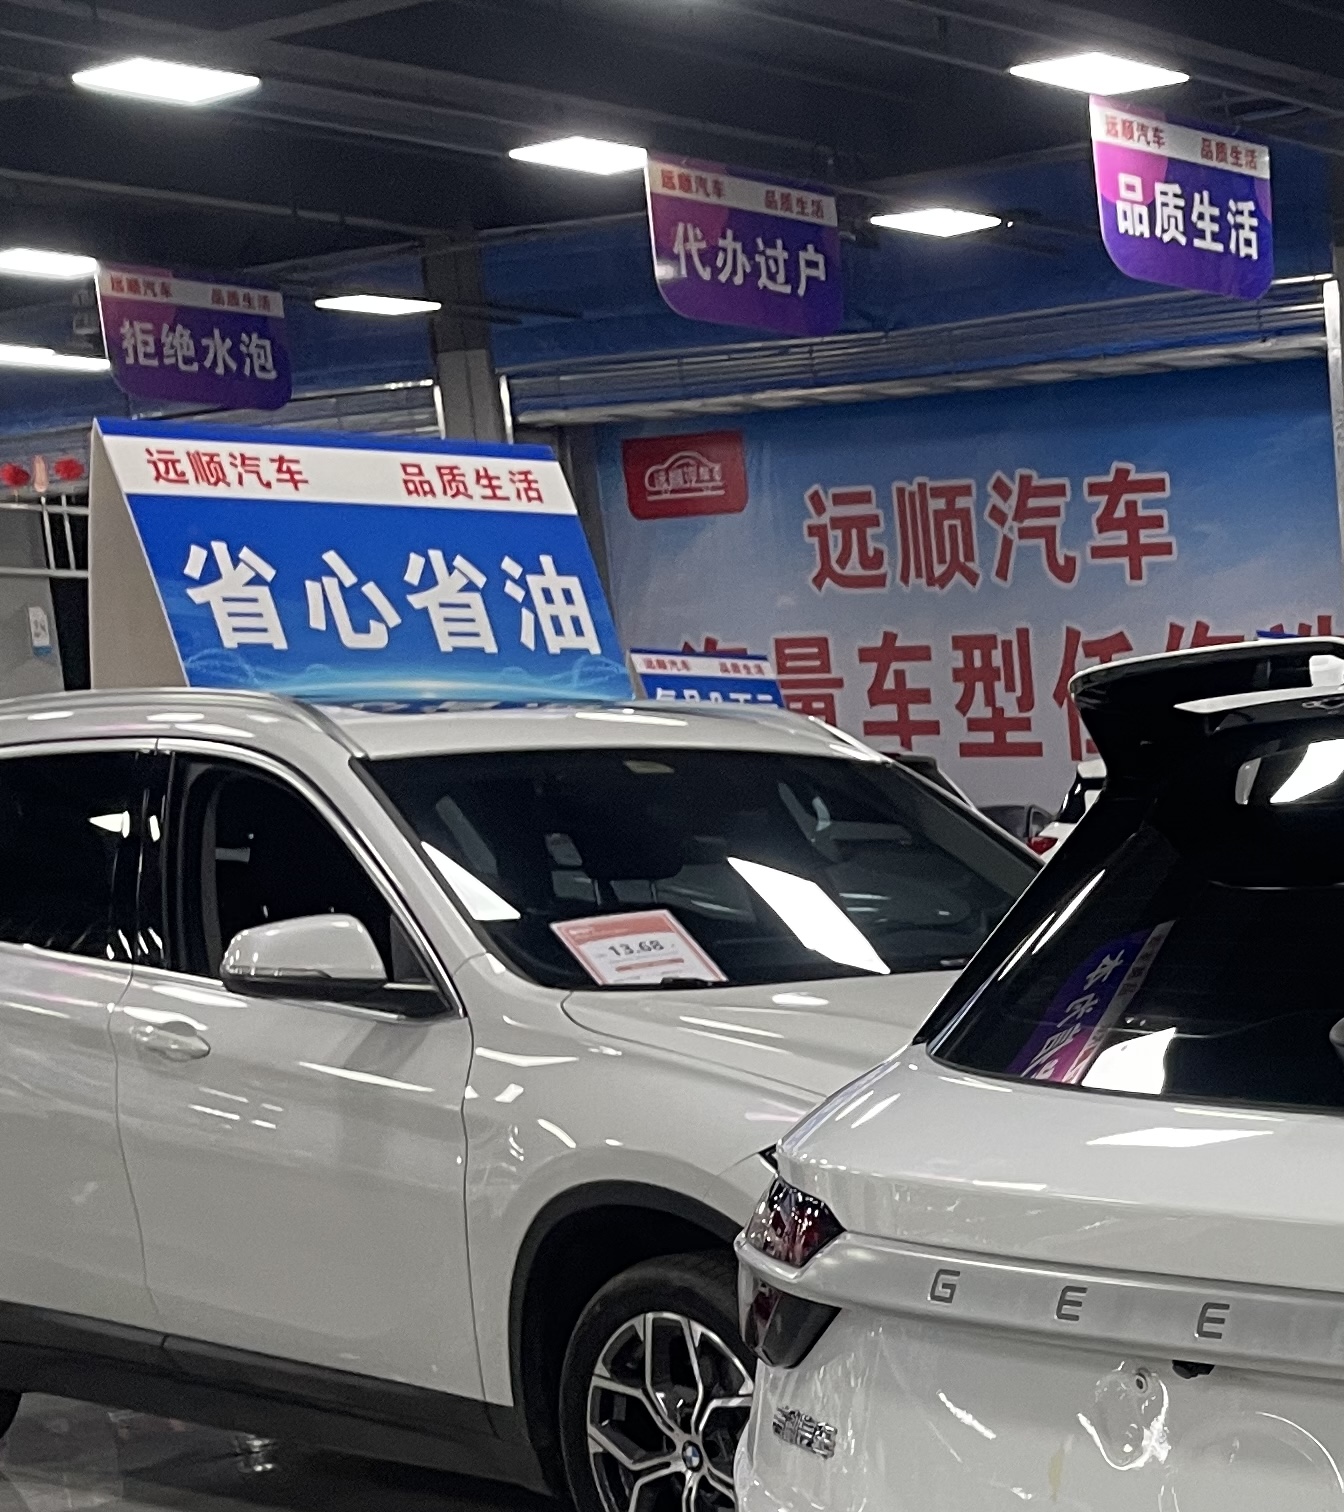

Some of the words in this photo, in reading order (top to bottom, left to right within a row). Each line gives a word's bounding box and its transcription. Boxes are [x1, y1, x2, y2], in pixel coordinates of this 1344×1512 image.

[1200, 137, 1258, 171] 品质生活
[1115, 172, 1259, 261] 品质生活
[673, 221, 827, 298] 代办过户
[119, 317, 279, 381] 拒绝水泡
[145, 447, 310, 492] 远顺汽车
[400, 462, 545, 504] 品质生活
[804, 463, 1176, 595] 远顺汽车
[183, 540, 602, 656] 省心省油
